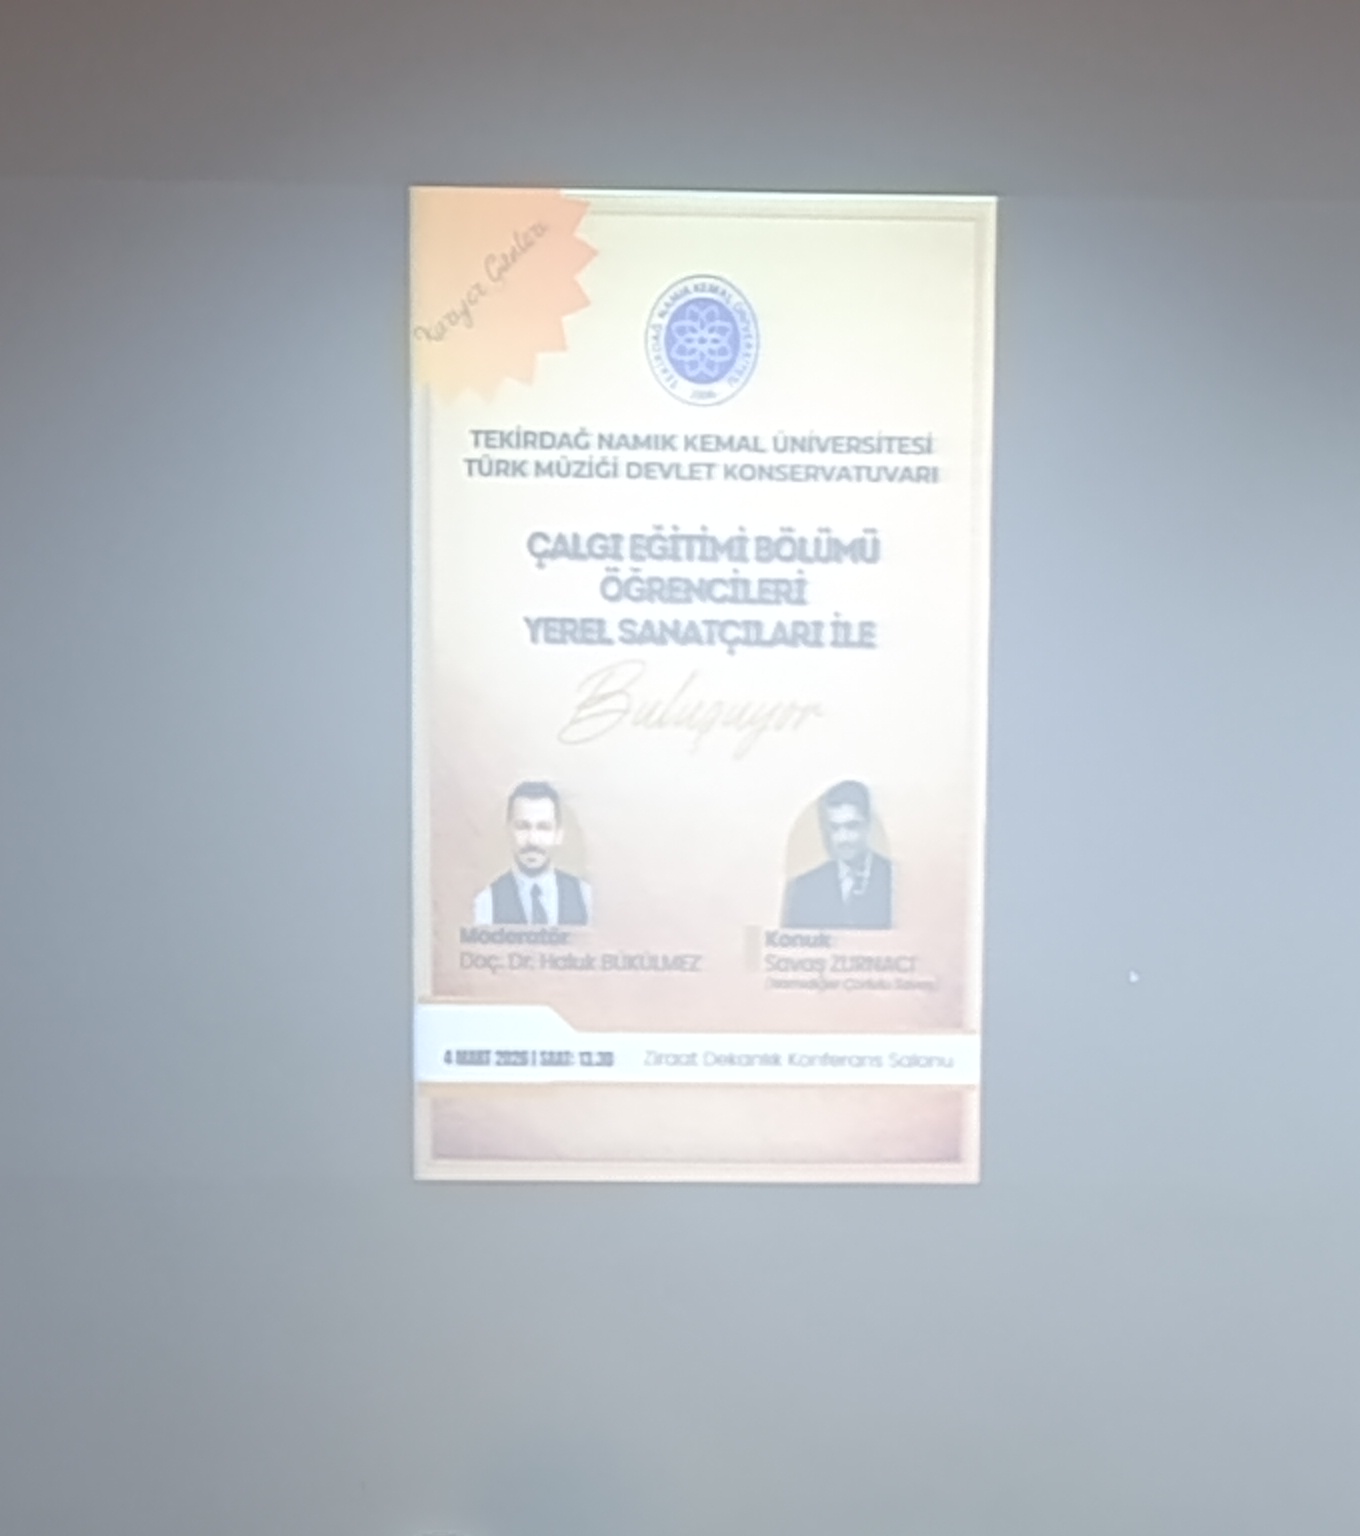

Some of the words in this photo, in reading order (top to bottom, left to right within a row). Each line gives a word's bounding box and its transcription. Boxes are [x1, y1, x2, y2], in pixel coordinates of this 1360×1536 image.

[469, 425, 590, 451] TEKİRDAĞ
[597, 432, 678, 452] NAMIK
[683, 433, 767, 454] KEMAL
[772, 428, 934, 455] ÜNİVERSİTESİ
[464, 454, 529, 479] TÜRK
[534, 454, 619, 480] MÜZİĞİ
[625, 461, 717, 481] DEVLET
[723, 462, 940, 484] KONSERVATUVARI
[526, 530, 625, 569] ÇALGI
[629, 524, 751, 563] EĞİTİMİ
[754, 525, 881, 564] BÖLÜMÜ
[599, 565, 809, 606] ÖĞRENCİLERİ
[523, 616, 616, 645] YEREL
[617, 617, 825, 656] SANATÇILARI
[830, 611, 878, 650] İLE
[644, 1049, 698, 1067] Ziraat
[788, 1050, 883, 1068] Konferans
[888, 1050, 954, 1069] Salonu
